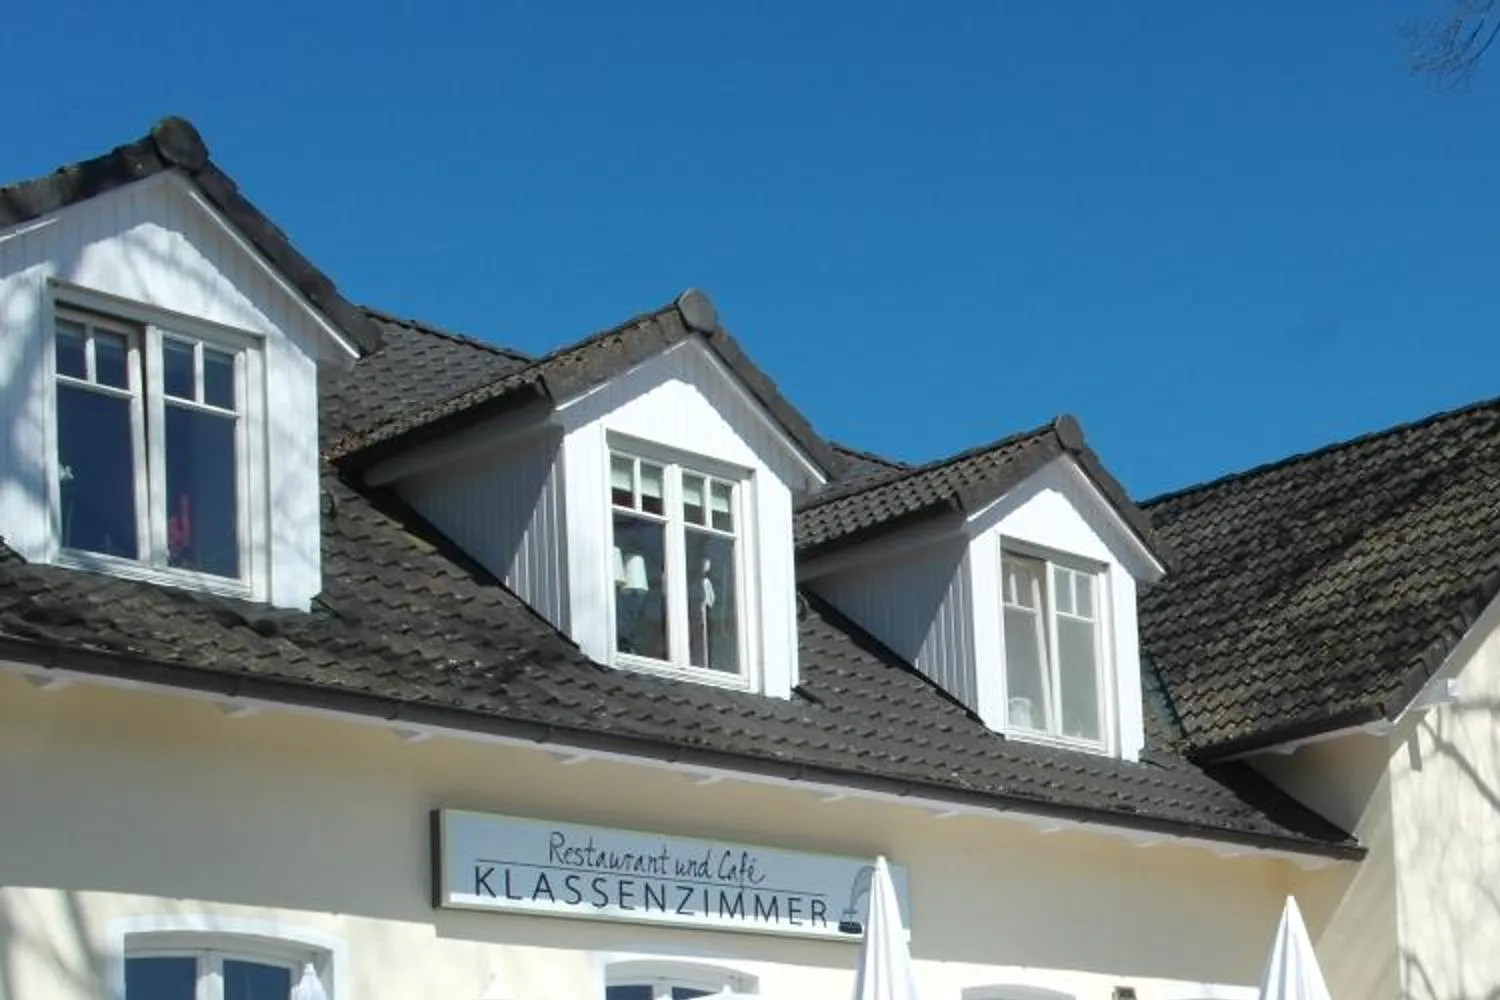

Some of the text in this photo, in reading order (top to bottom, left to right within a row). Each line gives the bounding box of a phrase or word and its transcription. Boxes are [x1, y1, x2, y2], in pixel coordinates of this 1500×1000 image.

[549, 831, 766, 887] Restaurant und Café
[475, 865, 827, 928] KLASSENZIMMER
